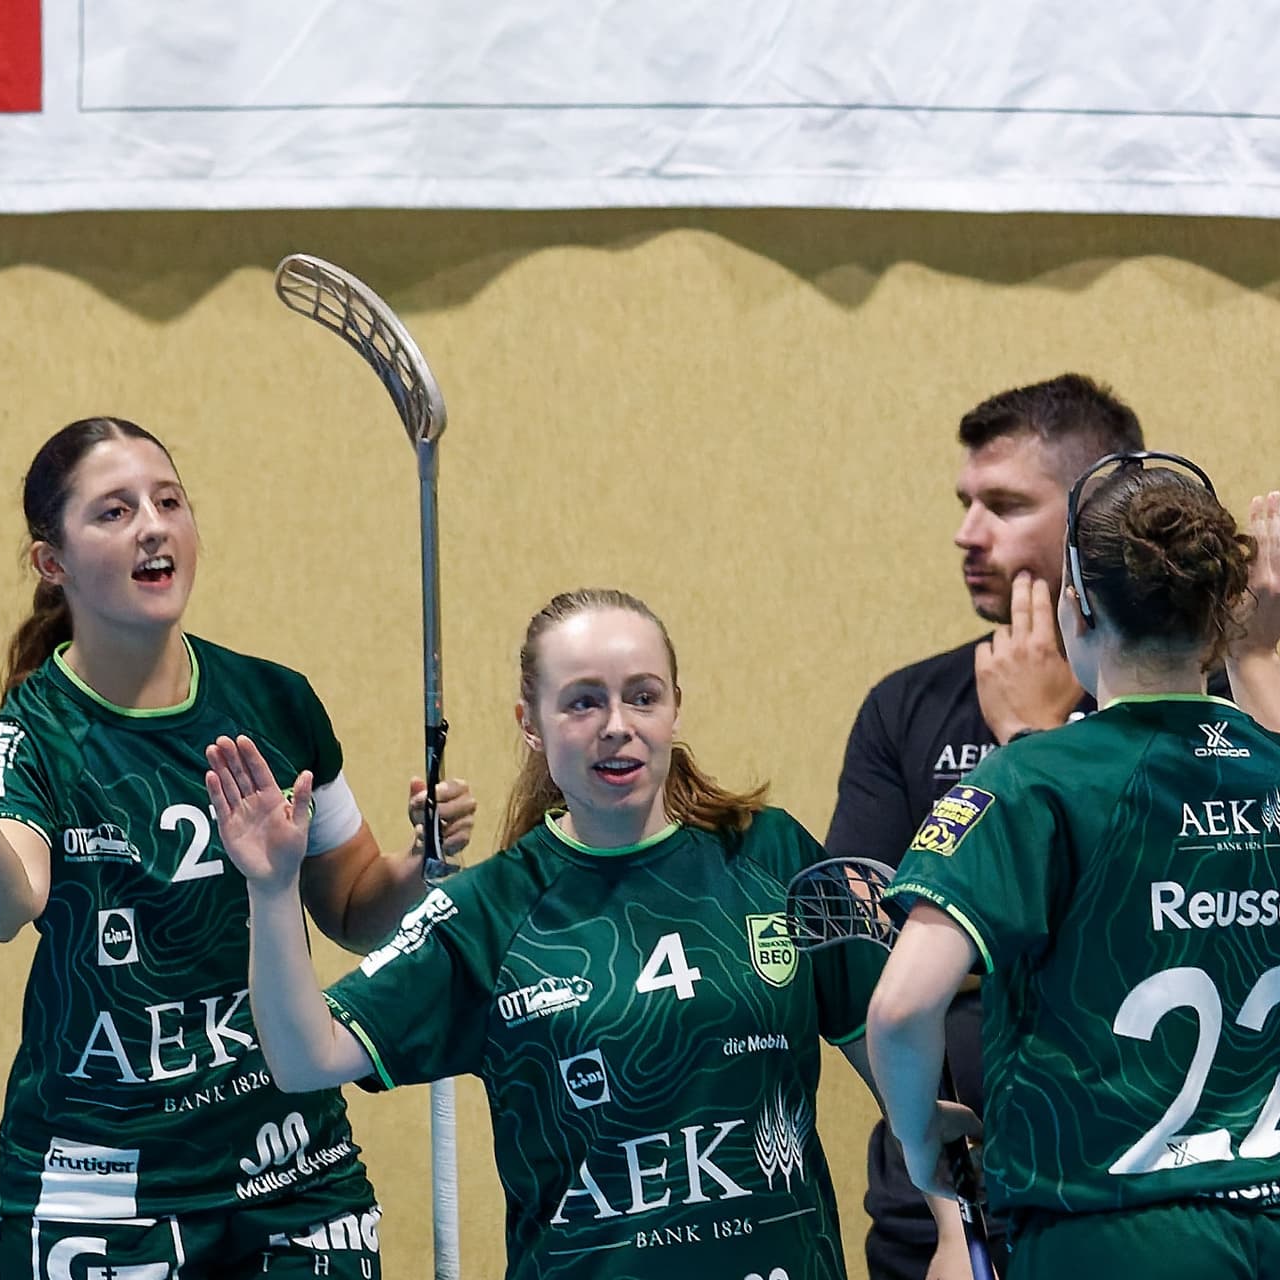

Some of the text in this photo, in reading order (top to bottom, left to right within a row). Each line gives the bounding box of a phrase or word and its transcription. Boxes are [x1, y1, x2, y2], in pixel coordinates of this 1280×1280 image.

[1178, 799, 1261, 837] AEK
[635, 931, 702, 1001] 4
[759, 949, 793, 965] BEO
[66, 988, 259, 1084] AEK
[164, 1069, 271, 1114] BANK 1826
[48, 1148, 136, 1176] Frutiger
[550, 1117, 754, 1226] AEK
[236, 1166, 298, 1200] Müller
[635, 1219, 754, 1250] BANK 1826
